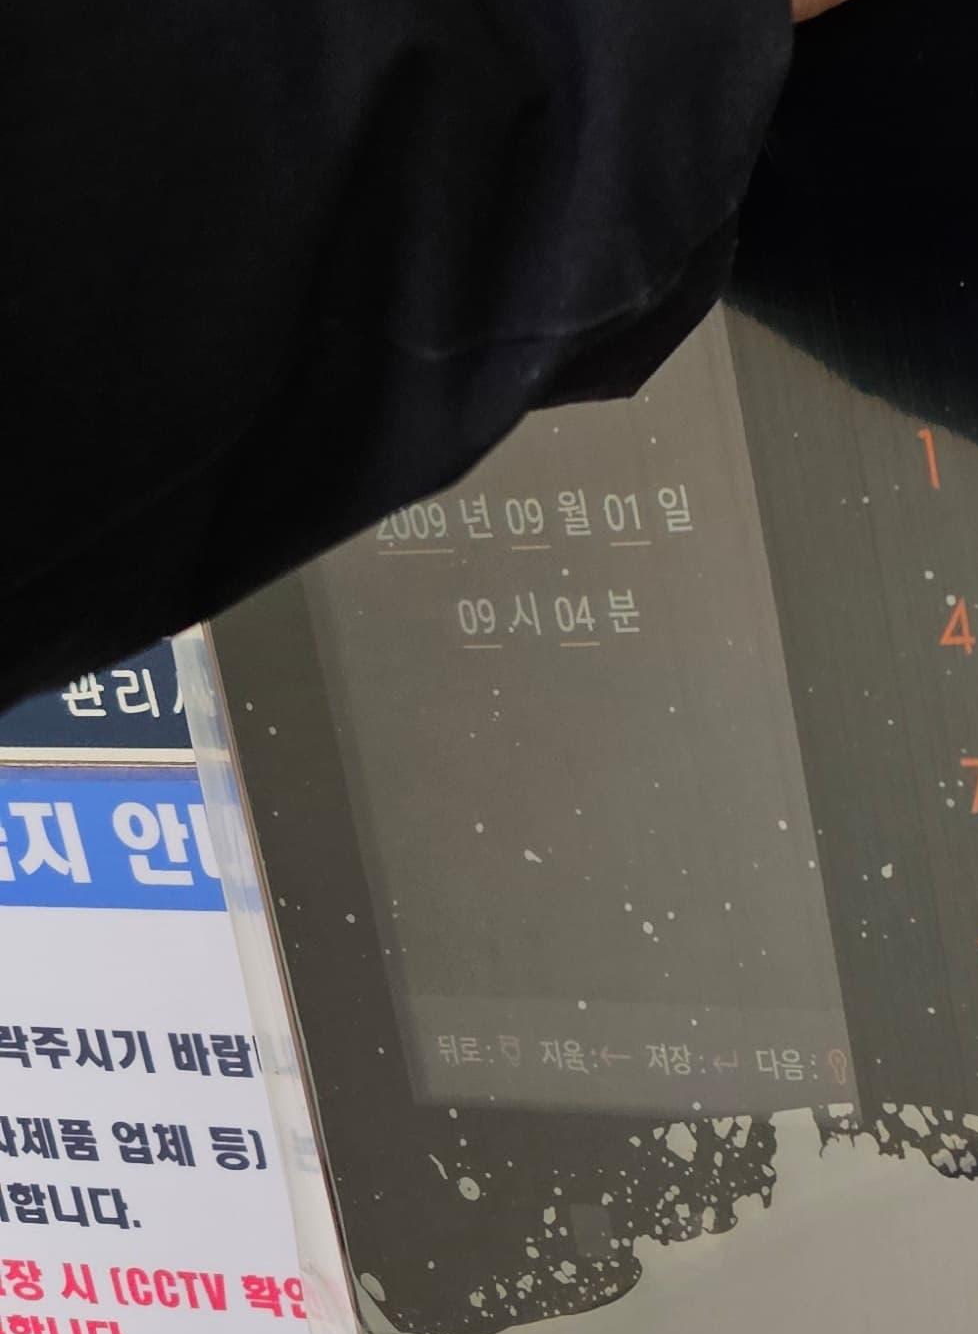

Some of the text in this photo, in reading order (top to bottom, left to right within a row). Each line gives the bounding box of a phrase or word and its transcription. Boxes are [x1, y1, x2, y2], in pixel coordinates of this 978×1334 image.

[918, 428, 940, 489] 1
[460, 493, 494, 539] 년
[505, 498, 545, 536] 09
[558, 489, 592, 536] 월
[603, 494, 642, 532] 01
[657, 484, 693, 532] 일
[457, 589, 641, 636] 09 시 04 분
[940, 598, 976, 654] 4
[61, 667, 184, 719] 관리
[168, 1032, 263, 1078] 바람
[111, 1121, 196, 1167] 업체
[208, 1126, 267, 1171] 등)
[0, 1182, 142, 1230] 합니다.
[61, 1262, 99, 1304] 시
[109, 1267, 228, 1311] (CCTV
